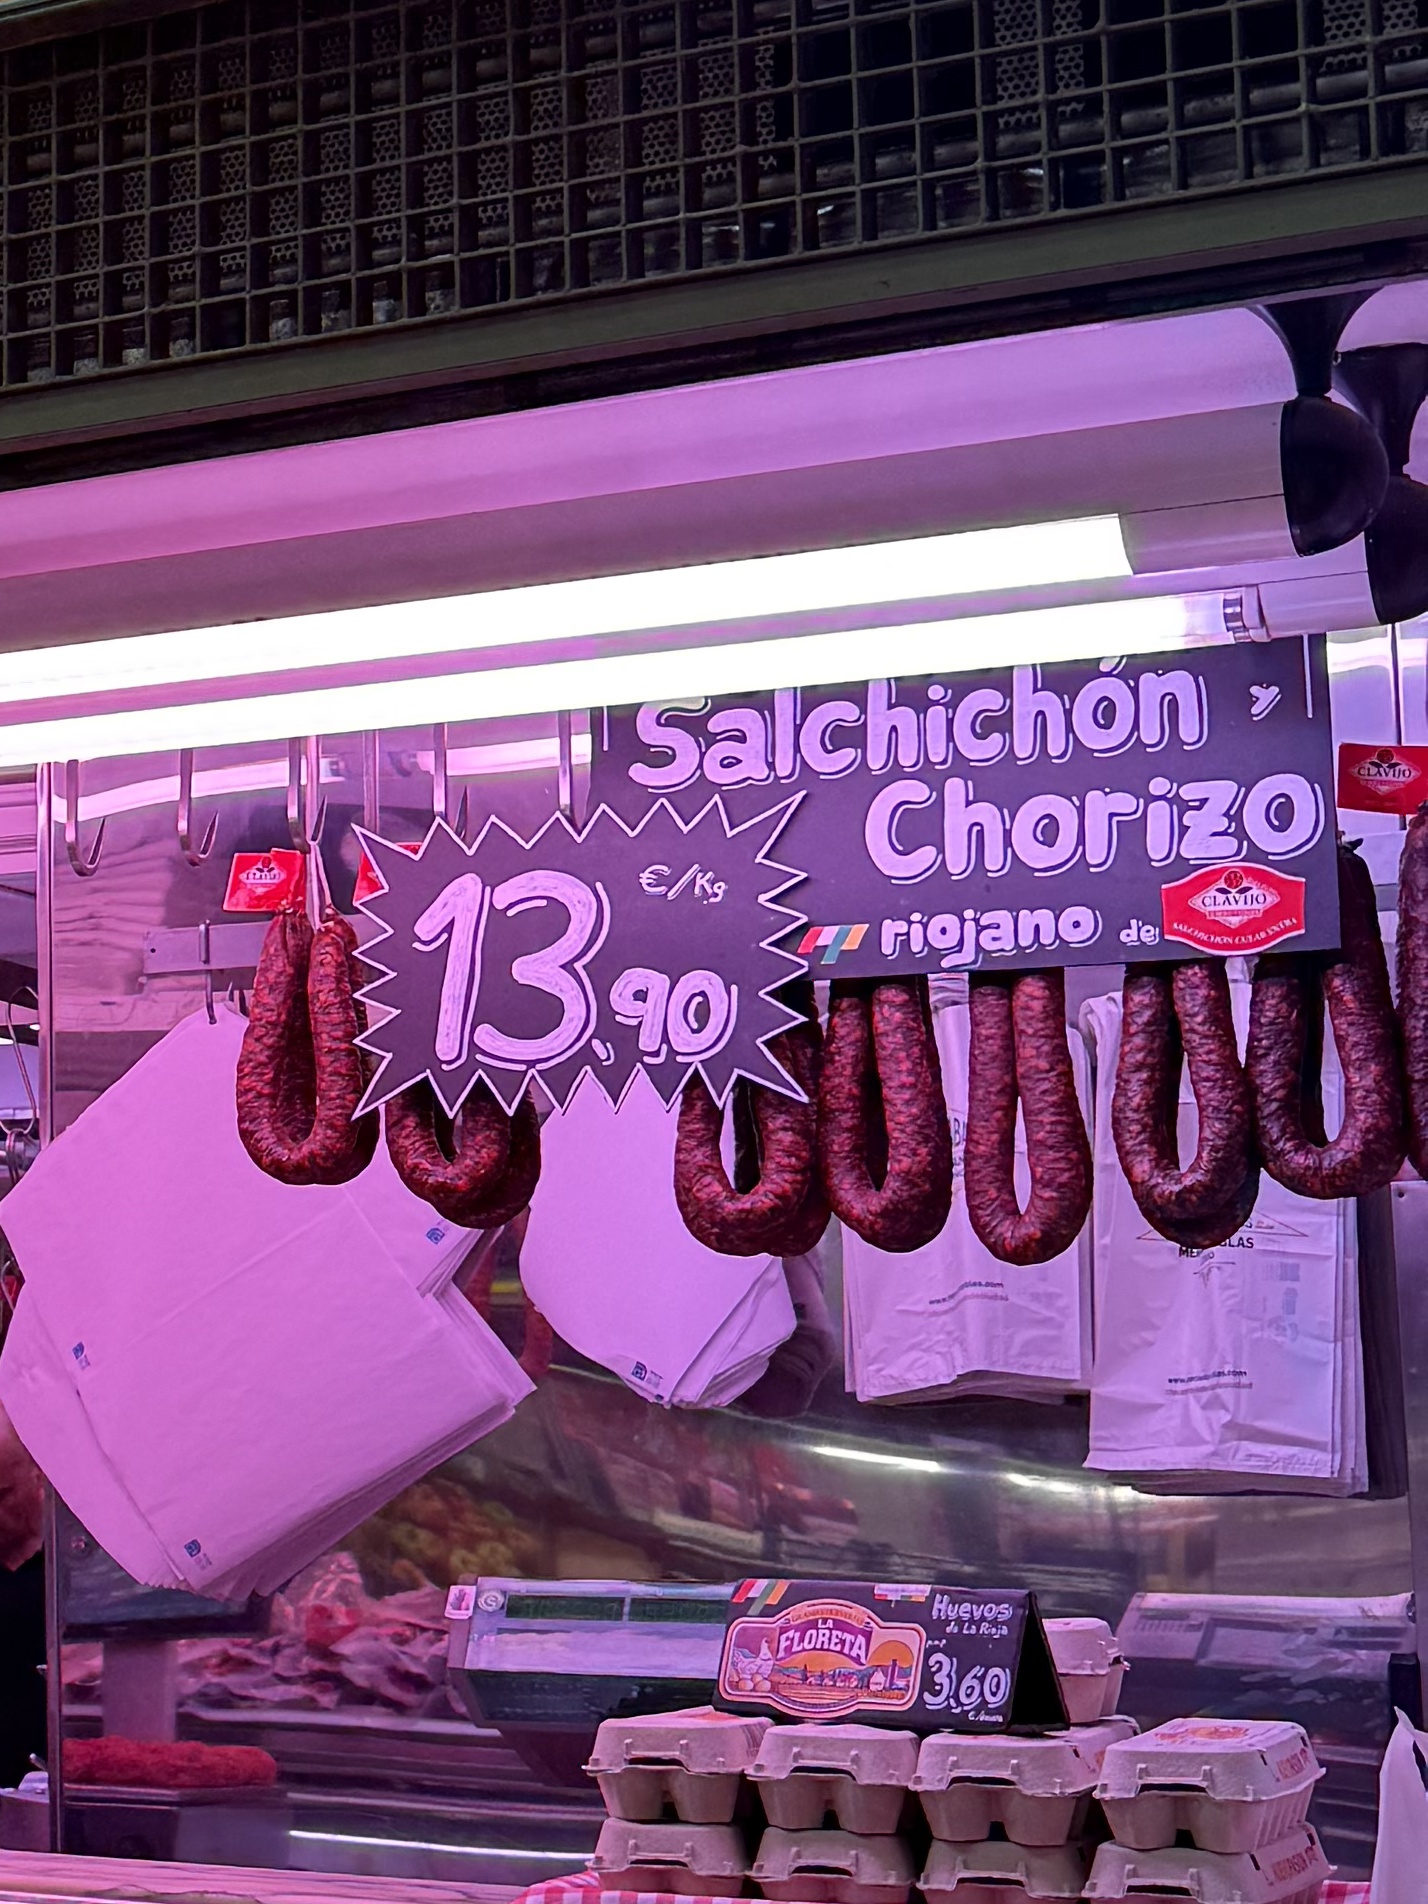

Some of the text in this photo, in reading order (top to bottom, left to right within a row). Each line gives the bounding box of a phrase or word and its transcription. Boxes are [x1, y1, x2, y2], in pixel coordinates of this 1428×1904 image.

[628, 655, 1281, 793] Salchichón y
[1358, 767, 1412, 778] CLAVIJO
[865, 772, 1326, 884] Chorizo
[1202, 894, 1267, 907] CLAVIJO
[880, 905, 1159, 968] riojano de
[931, 1594, 1012, 1621] Huevos
[817, 1619, 833, 1629] LA
[946, 1622, 1008, 1638] de La Rioja
[778, 1628, 867, 1664] FLORETA
